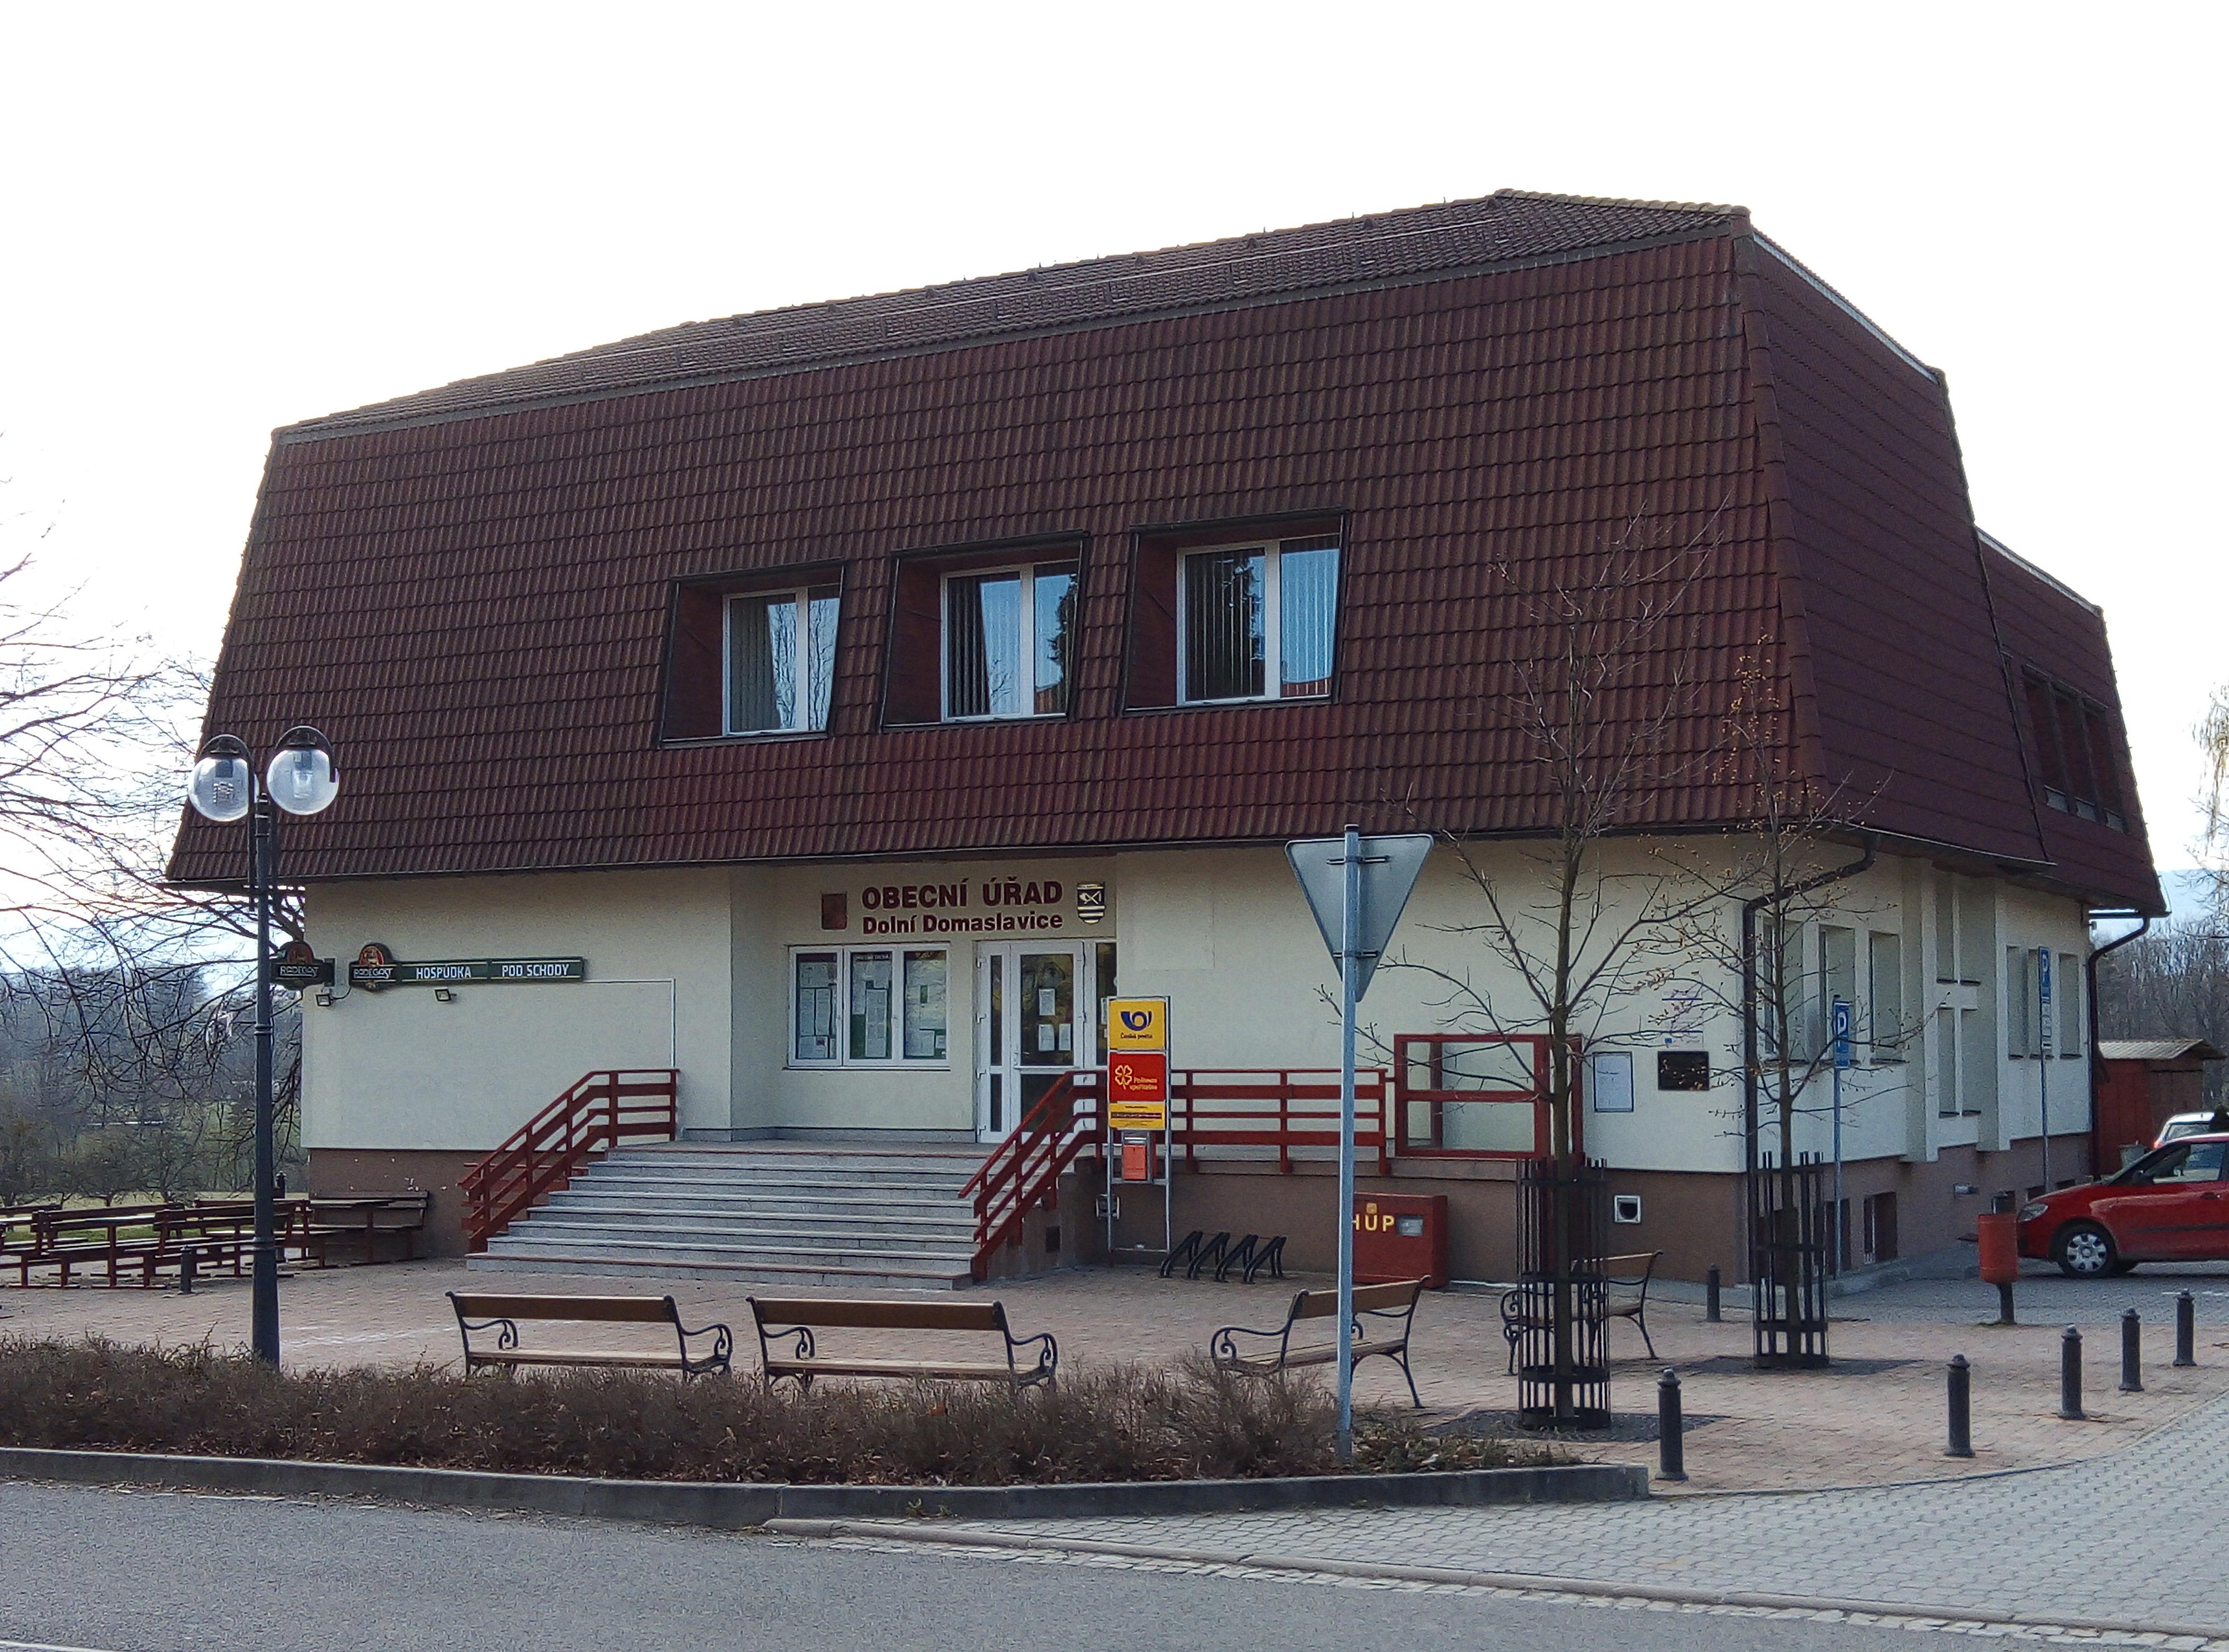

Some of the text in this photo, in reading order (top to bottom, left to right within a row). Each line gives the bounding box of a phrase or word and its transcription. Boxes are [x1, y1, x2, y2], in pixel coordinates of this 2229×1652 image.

[862, 876, 1063, 910] OBECNÍ ÚŘAD
[863, 910, 1063, 934] Dolní Domaslavice
[353, 968, 393, 979] RADEGAST
[502, 964, 570, 977] POD SCHODY
